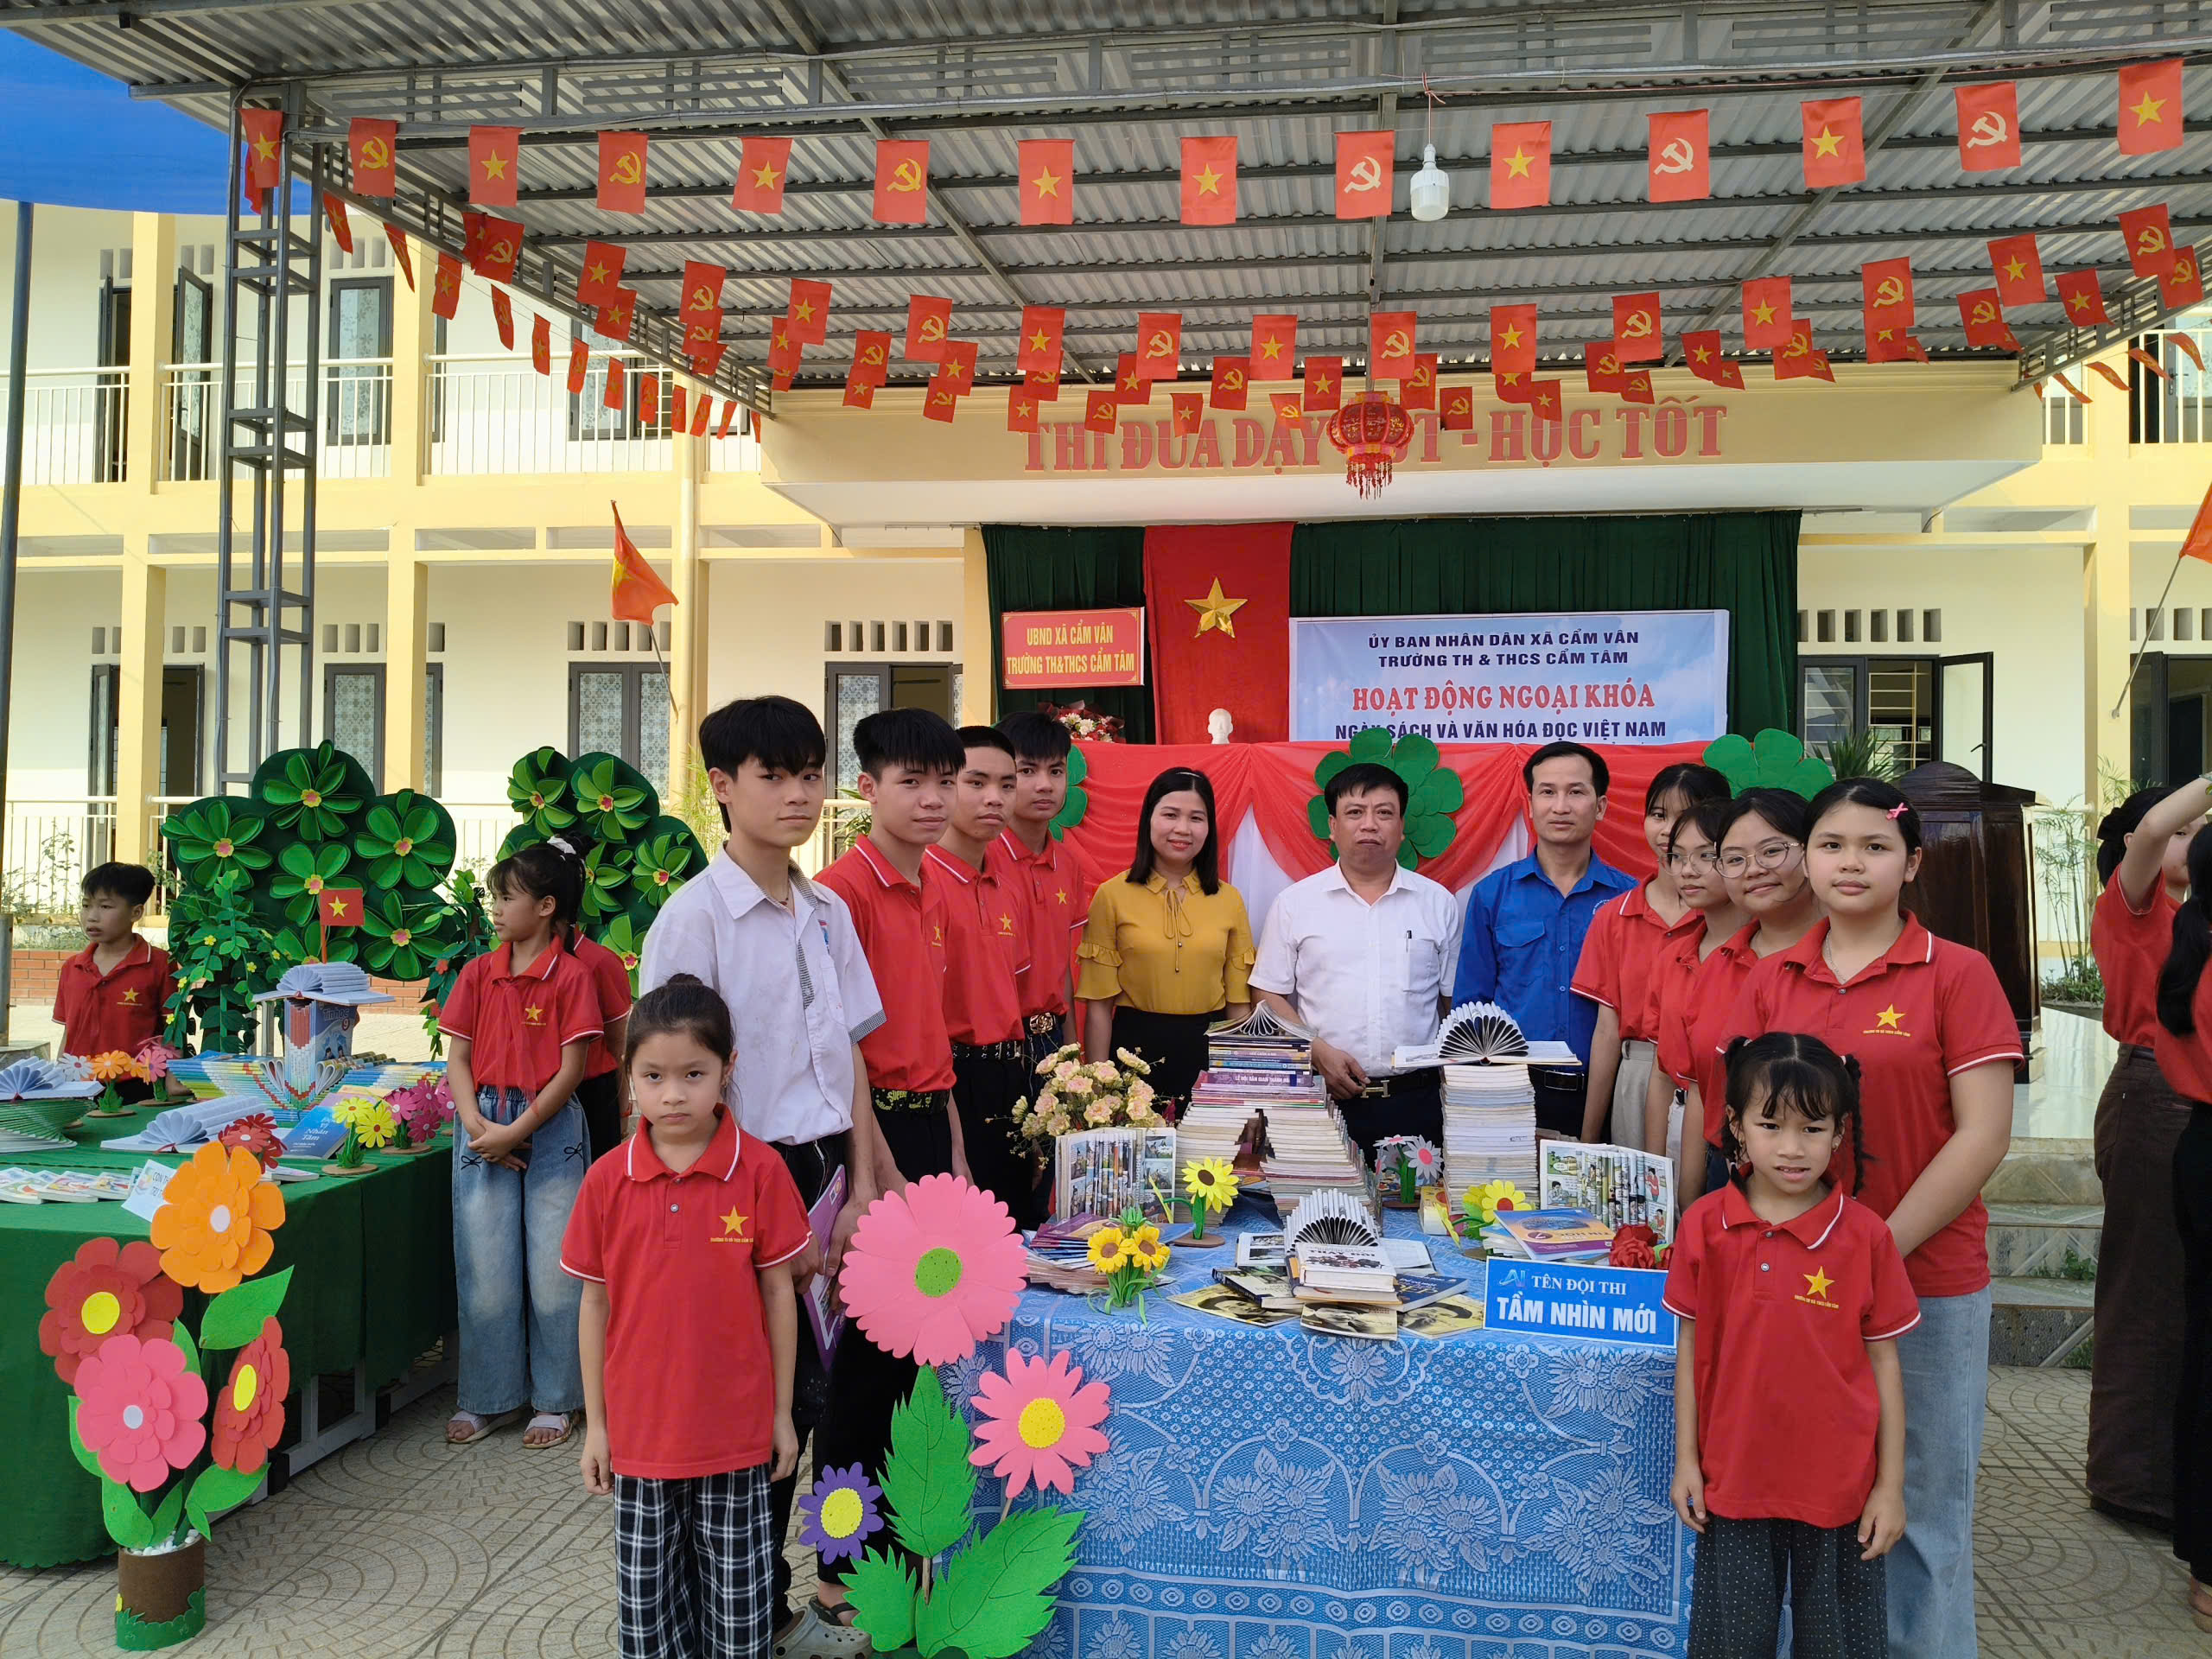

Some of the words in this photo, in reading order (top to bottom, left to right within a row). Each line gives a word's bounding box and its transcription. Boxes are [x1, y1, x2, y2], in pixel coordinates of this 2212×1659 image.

[1022, 421, 1108, 471] THI
[1120, 419, 1224, 470] ĐUA
[1232, 416, 1332, 475] DẠY
[1488, 409, 1600, 467] HỌC
[1616, 395, 1727, 459] TỐT
[1027, 627, 1052, 645] UBND
[1055, 624, 1068, 645] XÃ
[1070, 619, 1091, 645] CẨM
[1094, 622, 1114, 644] VÂN
[1369, 633, 1389, 648] ỦY
[1395, 636, 1430, 648] BAN
[1435, 632, 1484, 647] NHÂN
[1490, 632, 1525, 645] DÂN
[1530, 631, 1554, 645] XÃ
[1559, 628, 1598, 645] CẨM
[1603, 630, 1638, 644] VÂN
[1007, 652, 1043, 675] TRƯỜNG
[1046, 655, 1088, 674] TH&THCS
[1090, 647, 1111, 672] CẨM
[1114, 650, 1135, 671] TÂM
[1378, 652, 1447, 668] TRƯỜNG
[1452, 654, 1473, 666] TH
[1478, 654, 1491, 666] &
[1496, 653, 1541, 665] THCS
[1546, 648, 1585, 664] CẨM
[1590, 650, 1628, 664] TÂM
[1352, 687, 1419, 717] HOẠT
[1424, 679, 1492, 716] ĐỘNG
[1499, 684, 1578, 715] NGOẠI
[1584, 677, 1655, 708] KHÓA
[1386, 721, 1432, 739] SÁCH
[1437, 721, 1459, 739] VÀ
[1463, 720, 1497, 739] VĂN
[1503, 720, 1538, 738] HÓA
[1542, 721, 1578, 741] ĐỌC
[1583, 719, 1620, 741] VIỆT
[1625, 721, 1666, 737] NAM
[1531, 1273, 1562, 1290] TÊN
[1567, 1278, 1595, 1295] ĐỘI
[1599, 1281, 1627, 1295] THI
[1497, 1290, 1544, 1324] TẦM
[1550, 1300, 1605, 1330] NHÌN
[1613, 1302, 1656, 1334] MỚI
